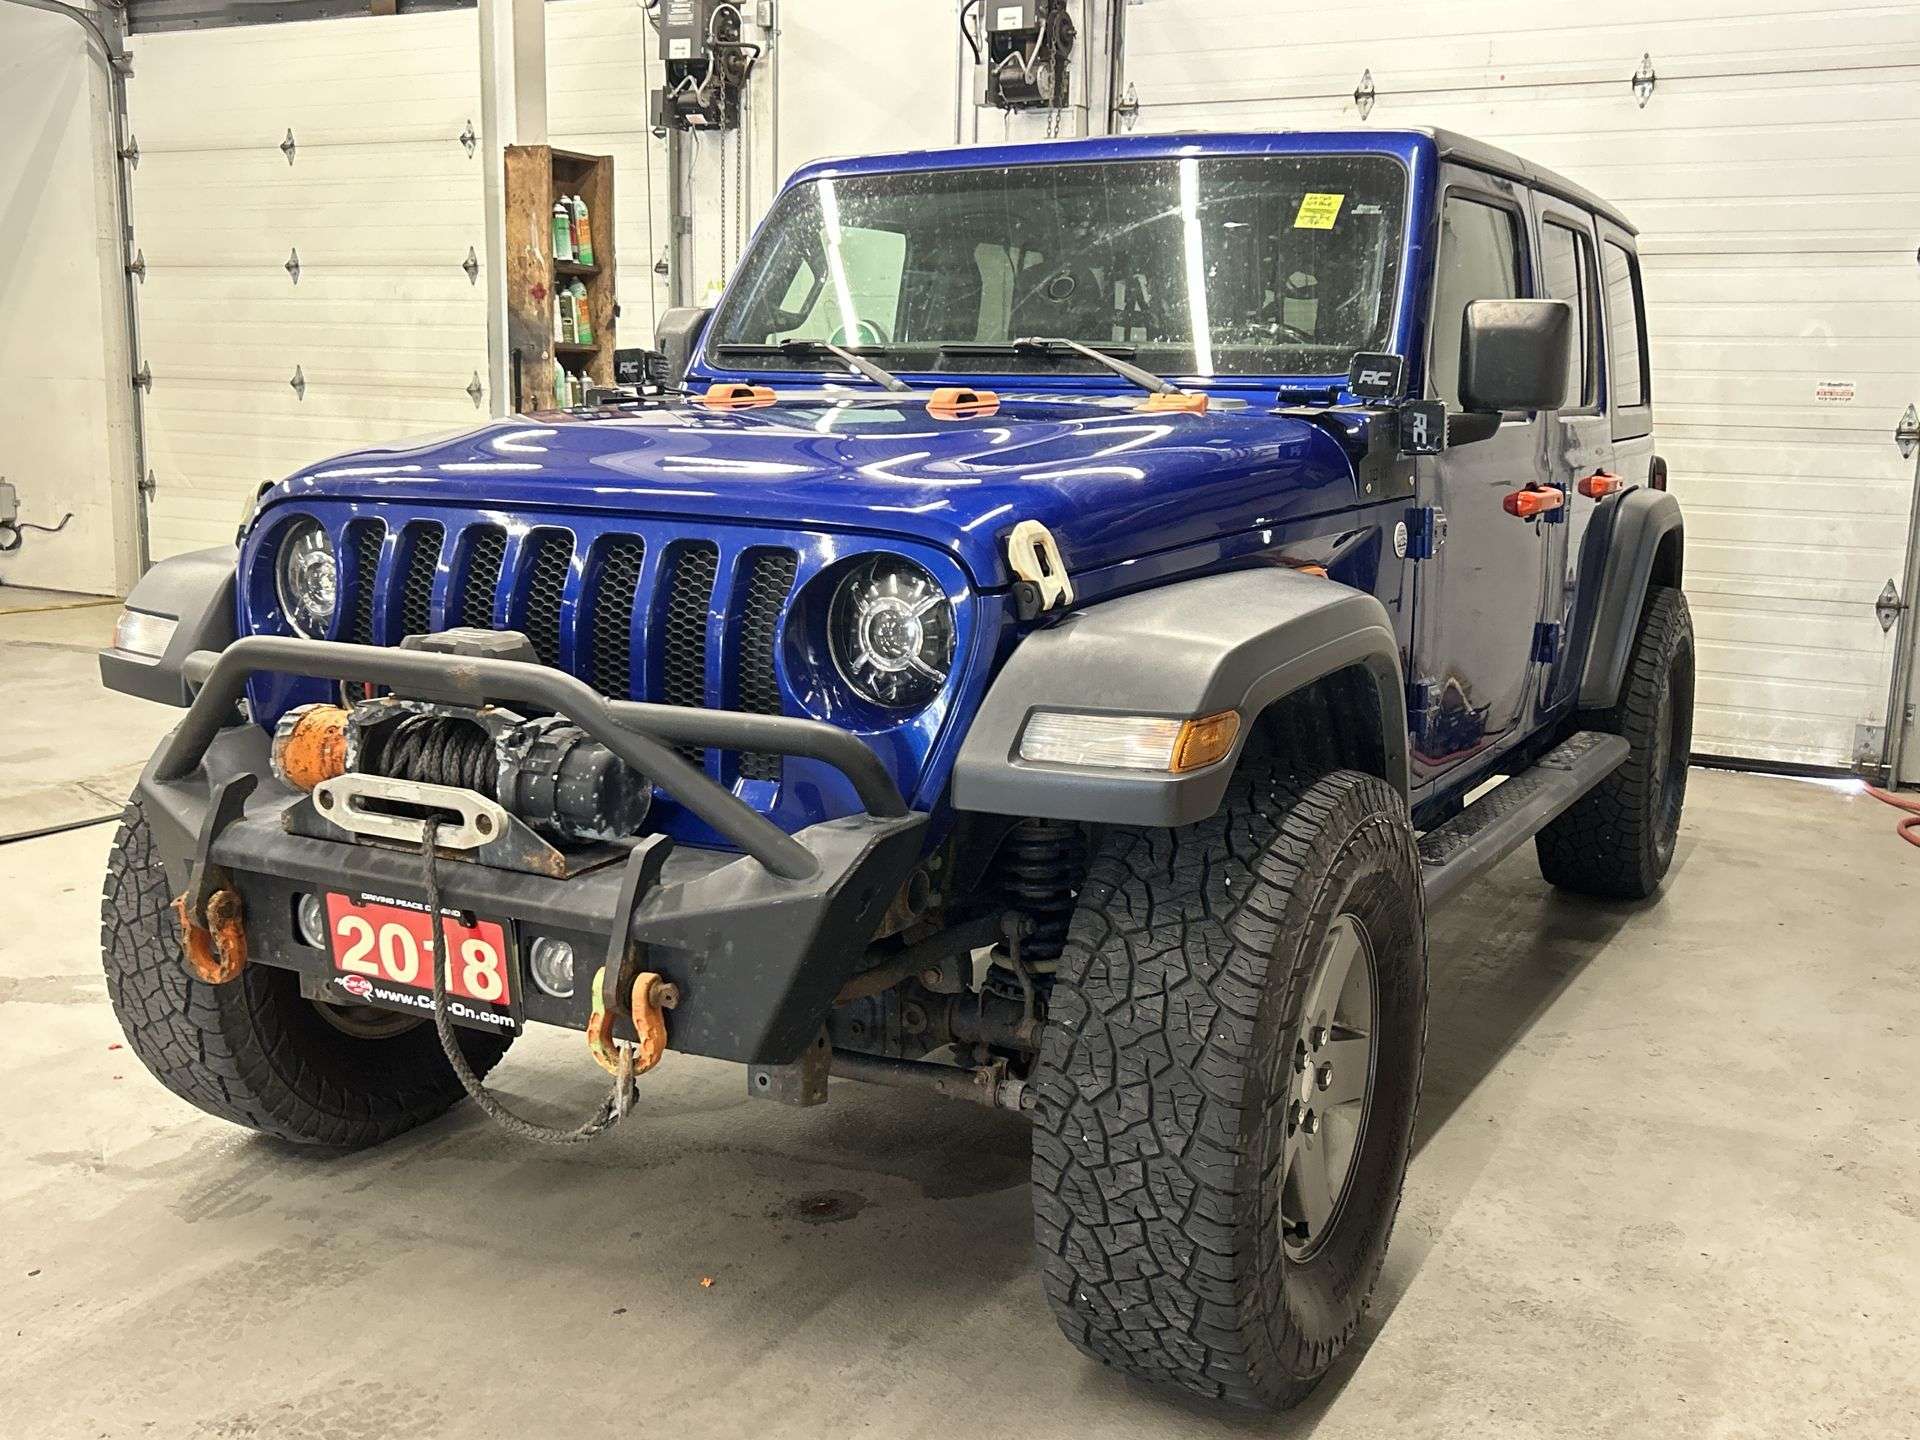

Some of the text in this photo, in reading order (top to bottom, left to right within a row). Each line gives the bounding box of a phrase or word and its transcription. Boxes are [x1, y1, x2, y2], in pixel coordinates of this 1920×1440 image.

[619, 361, 639, 374] RC
[1358, 370, 1392, 386] RC
[1412, 412, 1428, 445] RC
[361, 892, 395, 905] DRIVING
[395, 899, 424, 911] PEACE
[374, 987, 516, 1028] www.Ca-On.com
